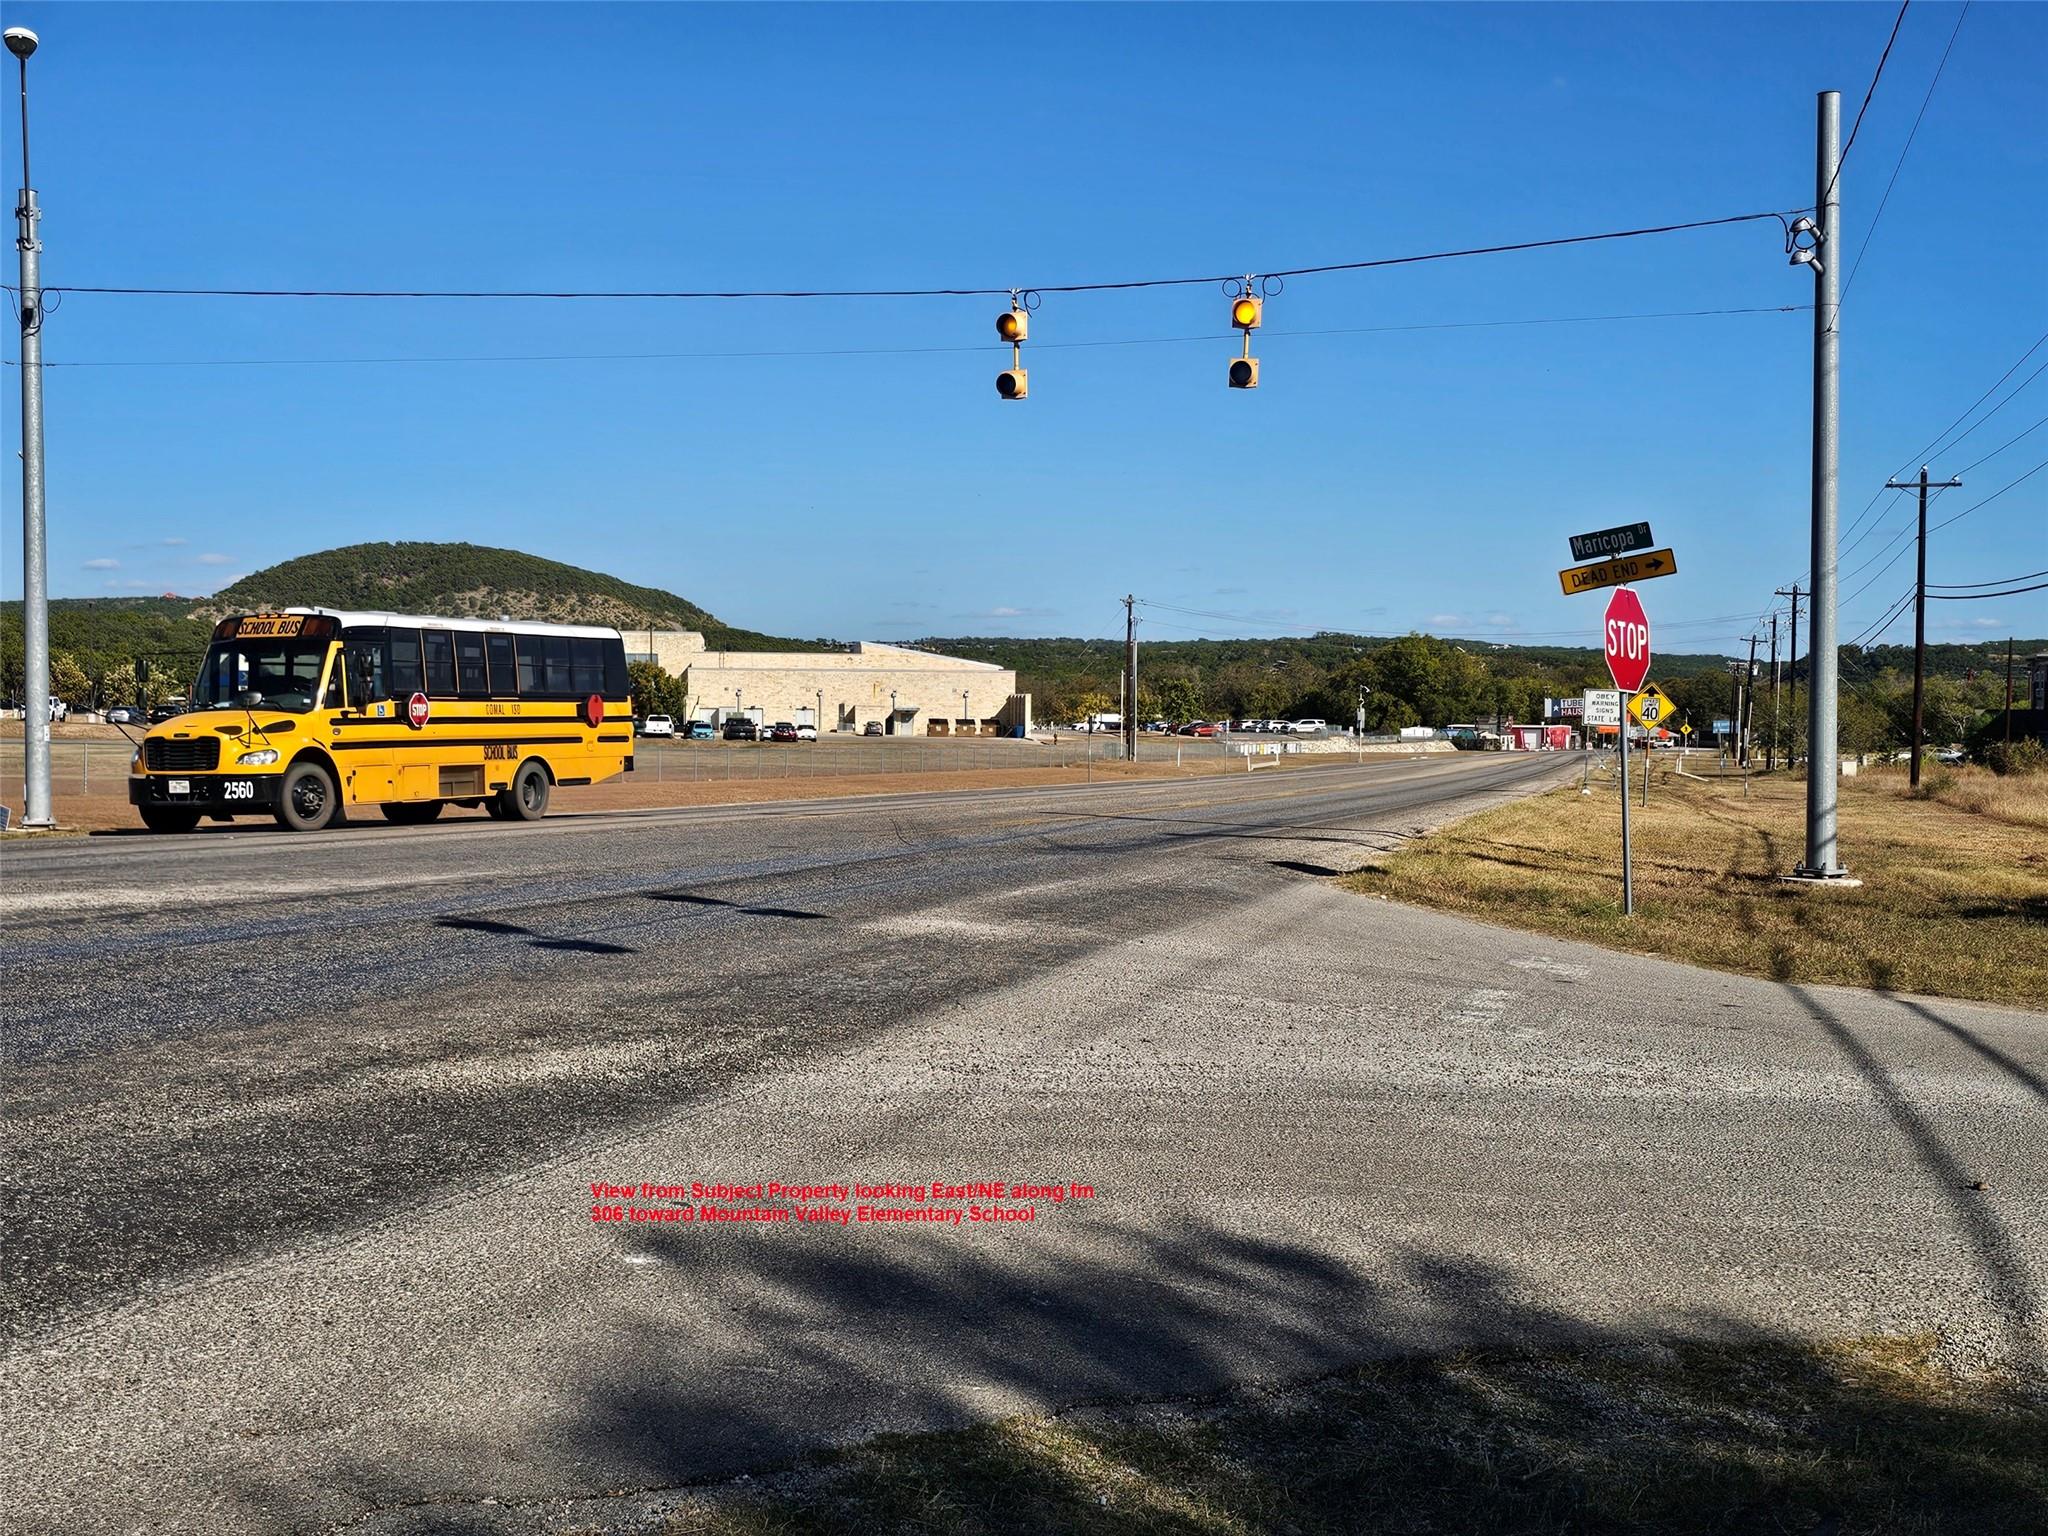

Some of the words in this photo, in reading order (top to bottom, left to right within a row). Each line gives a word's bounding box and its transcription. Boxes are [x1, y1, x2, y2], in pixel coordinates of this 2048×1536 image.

[1572, 531, 1635, 556] Maricopa
[1637, 524, 1647, 535] Dr
[1571, 568, 1607, 588] DEAD
[1612, 561, 1639, 578] END
[238, 621, 275, 635] SCHOOL
[277, 620, 301, 634] BUS
[1607, 618, 1647, 661] STOP
[411, 703, 427, 717] STOP
[485, 703, 505, 715] COMAL
[1562, 699, 1583, 708] TUBE
[1561, 708, 1584, 716] HAUS
[1642, 707, 1658, 720] 40
[483, 745, 506, 760] SCHOOL
[507, 744, 519, 759] BUS
[223, 780, 254, 799] 2560
